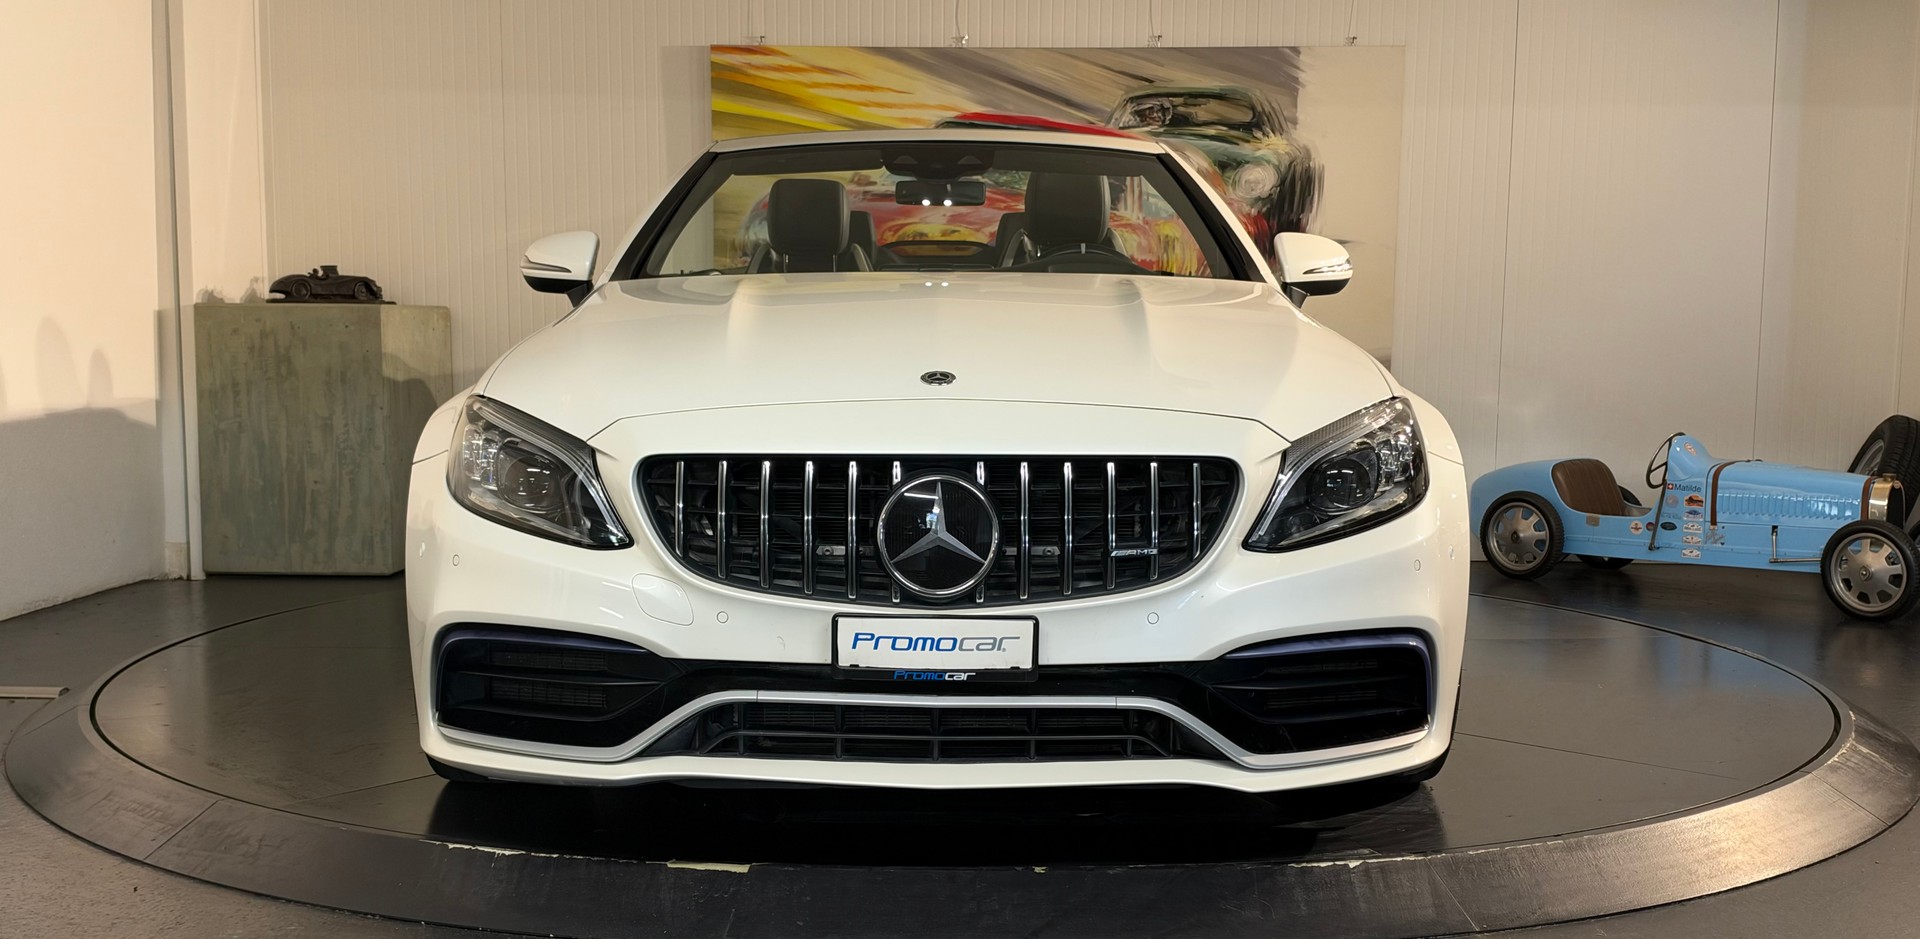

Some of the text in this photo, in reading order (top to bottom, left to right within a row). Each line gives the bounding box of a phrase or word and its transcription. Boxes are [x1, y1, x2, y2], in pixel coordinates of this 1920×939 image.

[1674, 483, 1702, 493] Matilde
[851, 632, 1021, 653] Promocar
[894, 670, 976, 681] Promocar
